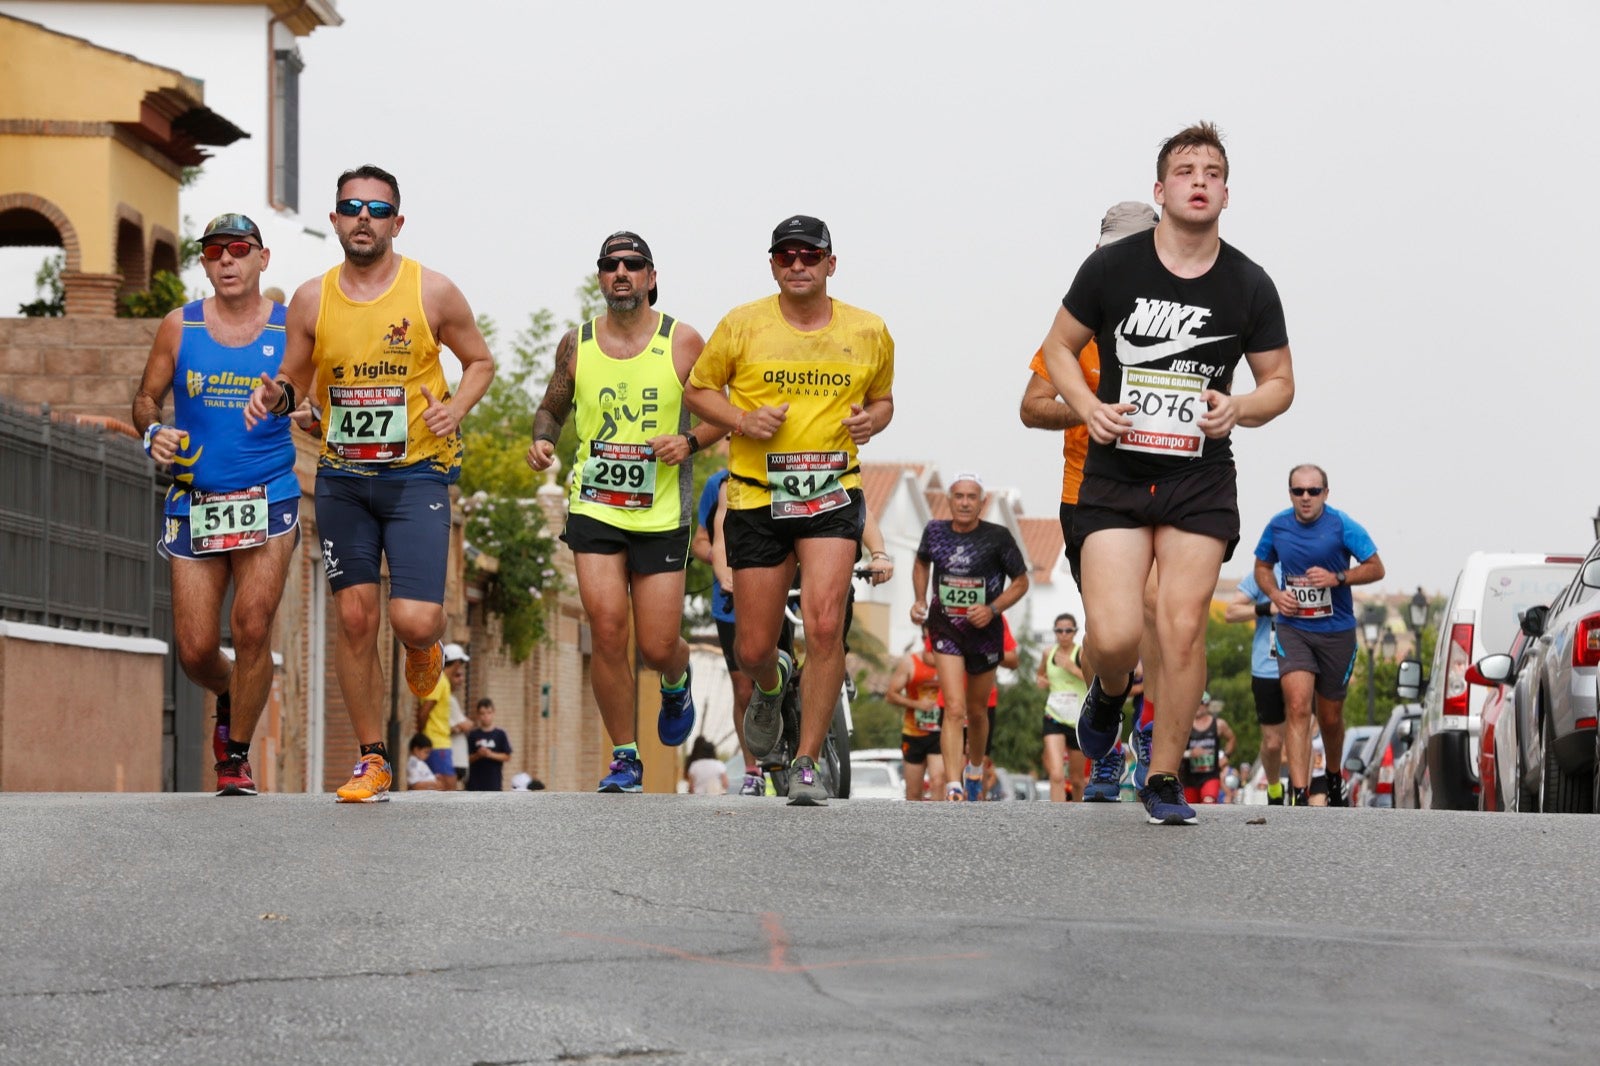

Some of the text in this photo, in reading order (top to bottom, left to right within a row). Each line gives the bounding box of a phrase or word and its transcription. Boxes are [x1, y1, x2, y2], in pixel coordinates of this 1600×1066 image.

[1123, 297, 1212, 340] NIKE
[354, 361, 408, 379] Vigilsa
[1169, 359, 1199, 373] JUST
[208, 371, 263, 390] olimp
[763, 369, 851, 388] agustinos
[206, 386, 248, 395] deportes
[354, 389, 375, 398] PREMIO
[375, 389, 383, 398] DE
[778, 387, 838, 397] GRANADA
[203, 400, 227, 408] TRAIL
[236, 401, 249, 409] RU
[1126, 389, 1196, 423] 3076
[340, 410, 394, 438] 427
[1127, 431, 1185, 449] Cruzcampo
[786, 454, 801, 464] GRAN
[801, 453, 821, 463] PREMIO
[821, 453, 827, 462] DE
[594, 461, 645, 488] 299
[204, 503, 256, 531] 518
[946, 589, 978, 604] 429
[1520, 580, 1562, 595] FLO
